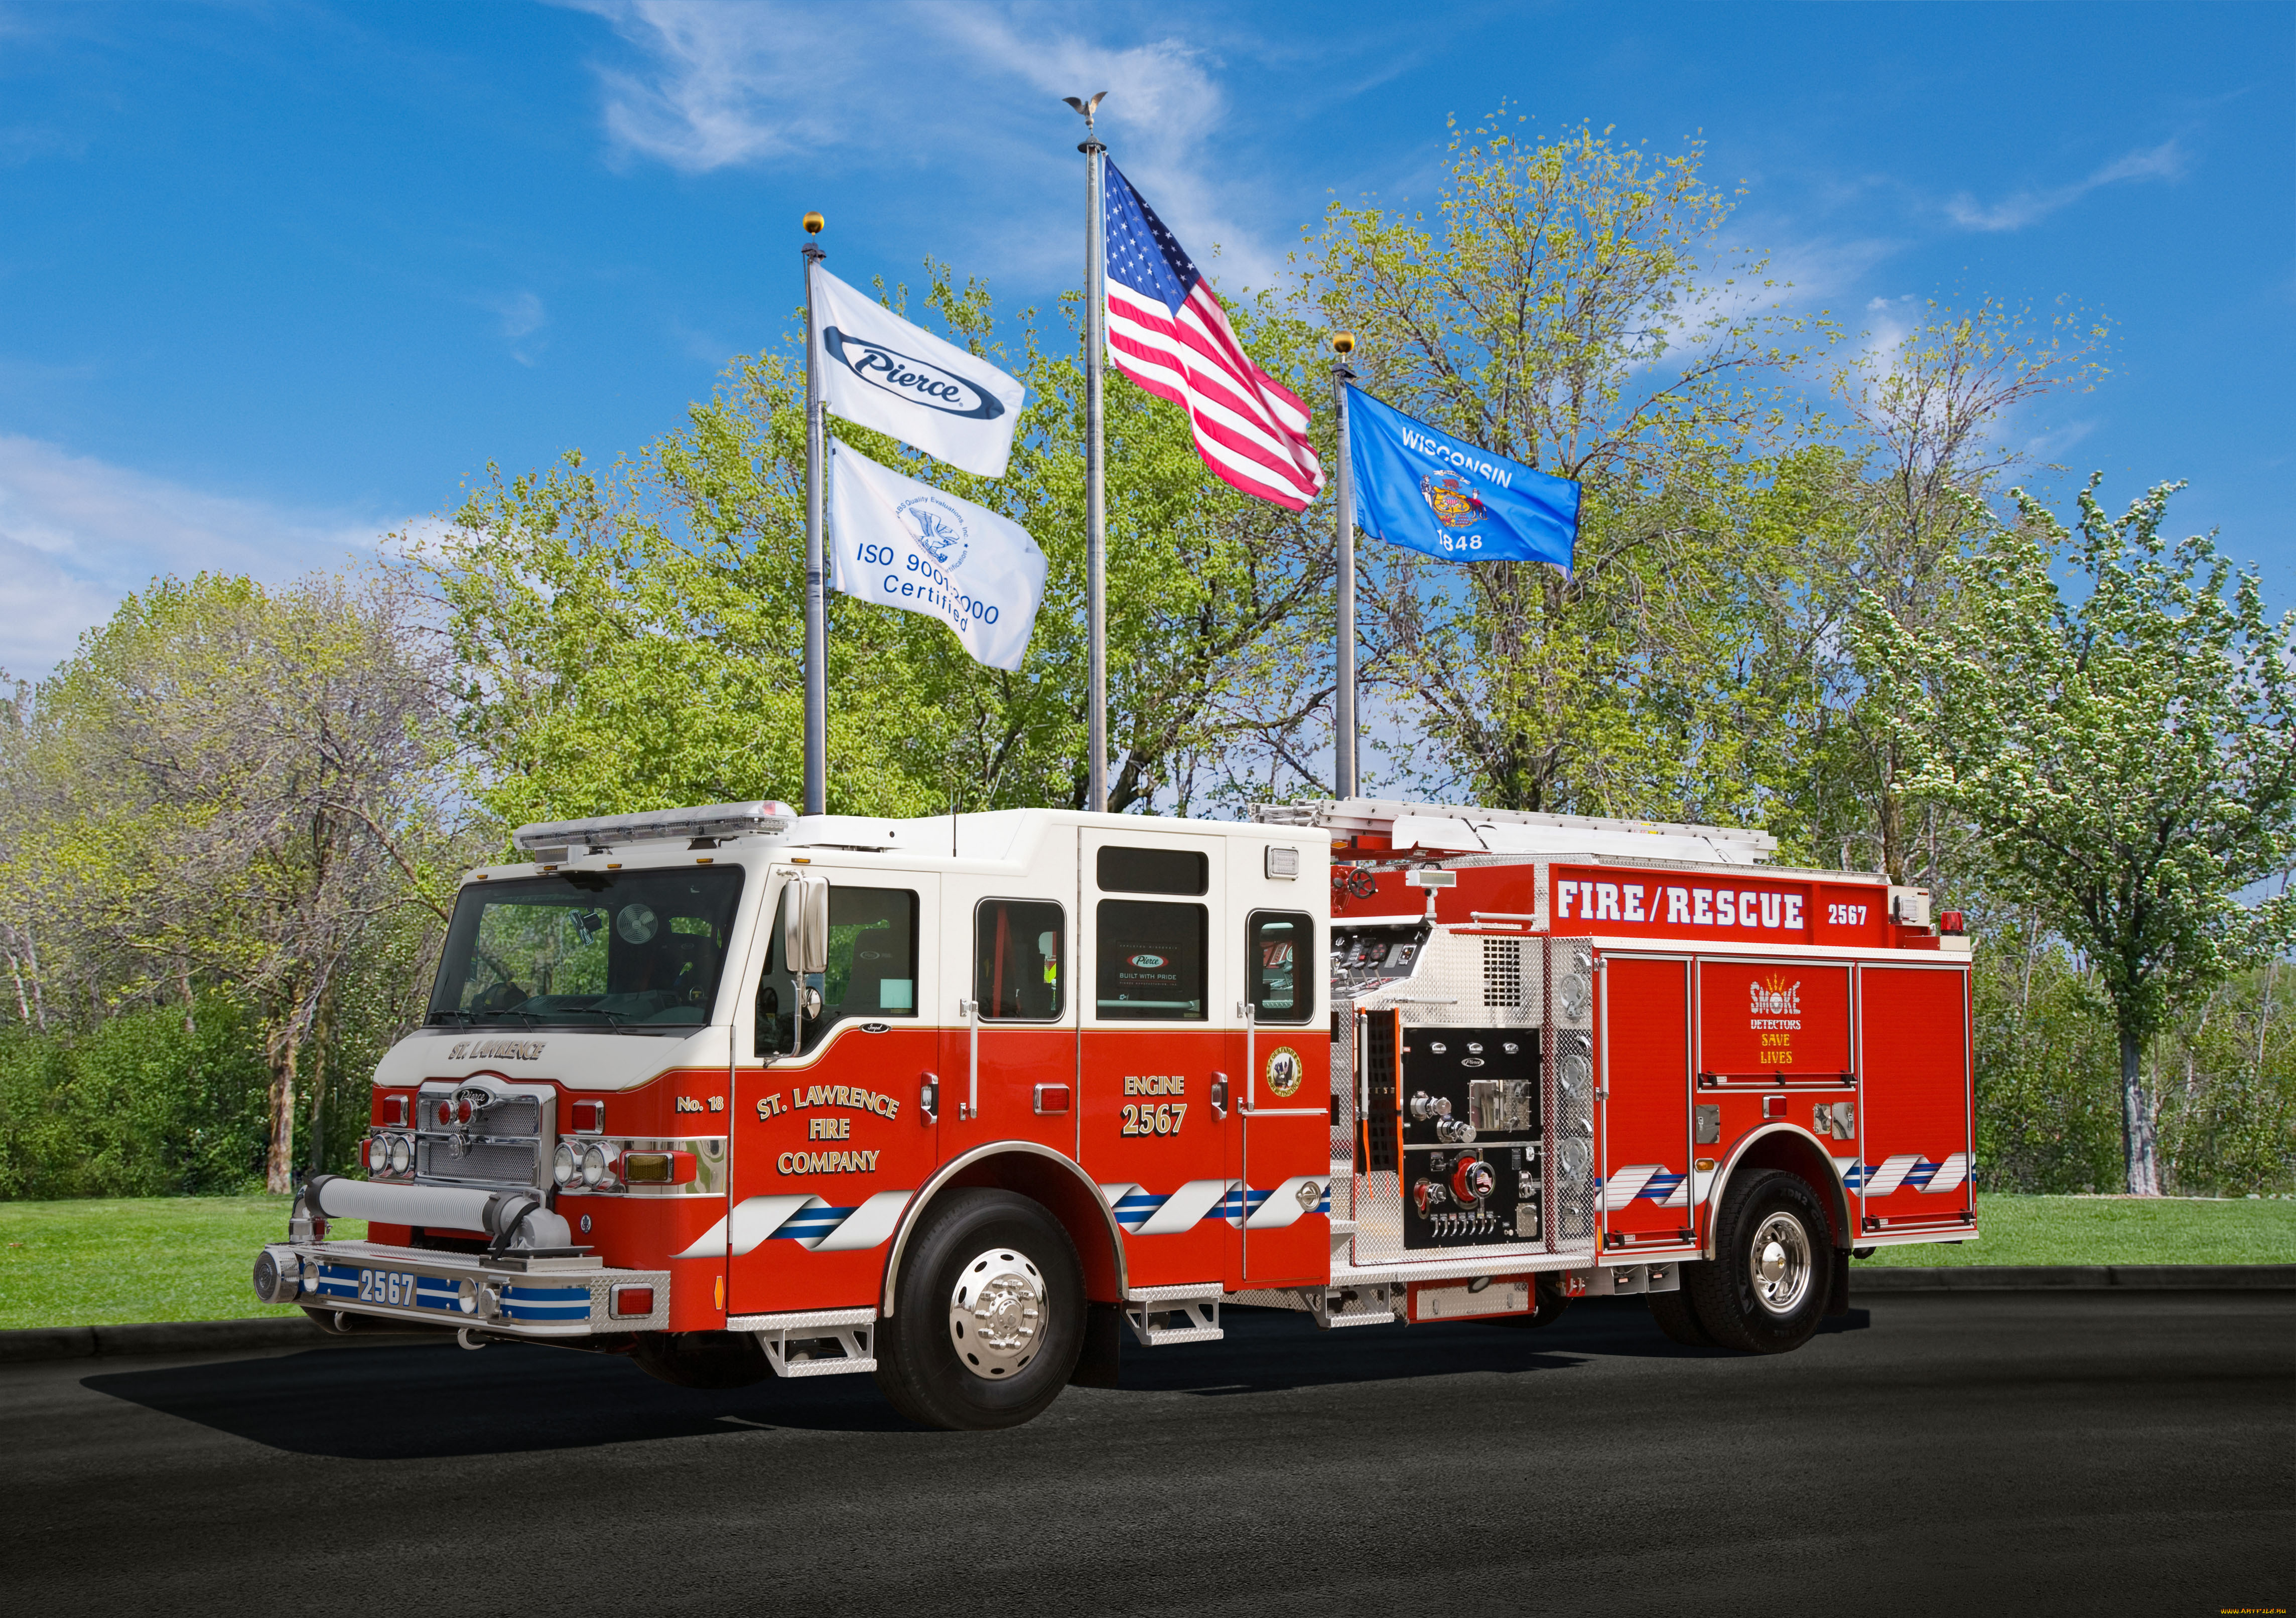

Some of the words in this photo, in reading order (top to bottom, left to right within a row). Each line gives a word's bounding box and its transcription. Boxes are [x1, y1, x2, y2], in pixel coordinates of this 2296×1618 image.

[854, 349, 961, 402] Pierce
[1403, 426, 1513, 489] WISCONSIN
[895, 503, 906, 515] ABS
[905, 497, 928, 506] Quality
[930, 496, 964, 525] Evaluations,
[1437, 529, 1482, 551] 1848
[857, 543, 894, 565] ISO
[906, 554, 999, 624] 9001:2000
[884, 575, 968, 632] Certified
[1557, 880, 1804, 930] FIRE/RESCUE
[1828, 904, 1867, 926] 2567
[1136, 956, 1159, 965] Pierce
[1750, 981, 1801, 1014] SMOKE
[1750, 1019, 1801, 1029] DETECTORS
[448, 1041, 471, 1060] ST.
[469, 1040, 548, 1061] LAWRENCE
[1762, 1034, 1790, 1046] SAVE
[1761, 1051, 1793, 1064] LIVES
[460, 1090, 485, 1101] Pierce
[1124, 1076, 1184, 1095] ENGINE
[677, 1096, 704, 1112] No.
[708, 1096, 724, 1112] 18
[757, 1093, 787, 1120] ST.
[793, 1085, 900, 1120] LAWRENCE
[809, 1118, 850, 1139] FIRE
[1122, 1103, 1187, 1134] 2567
[777, 1150, 880, 1174] COMPANY
[360, 1268, 415, 1306] 2567
